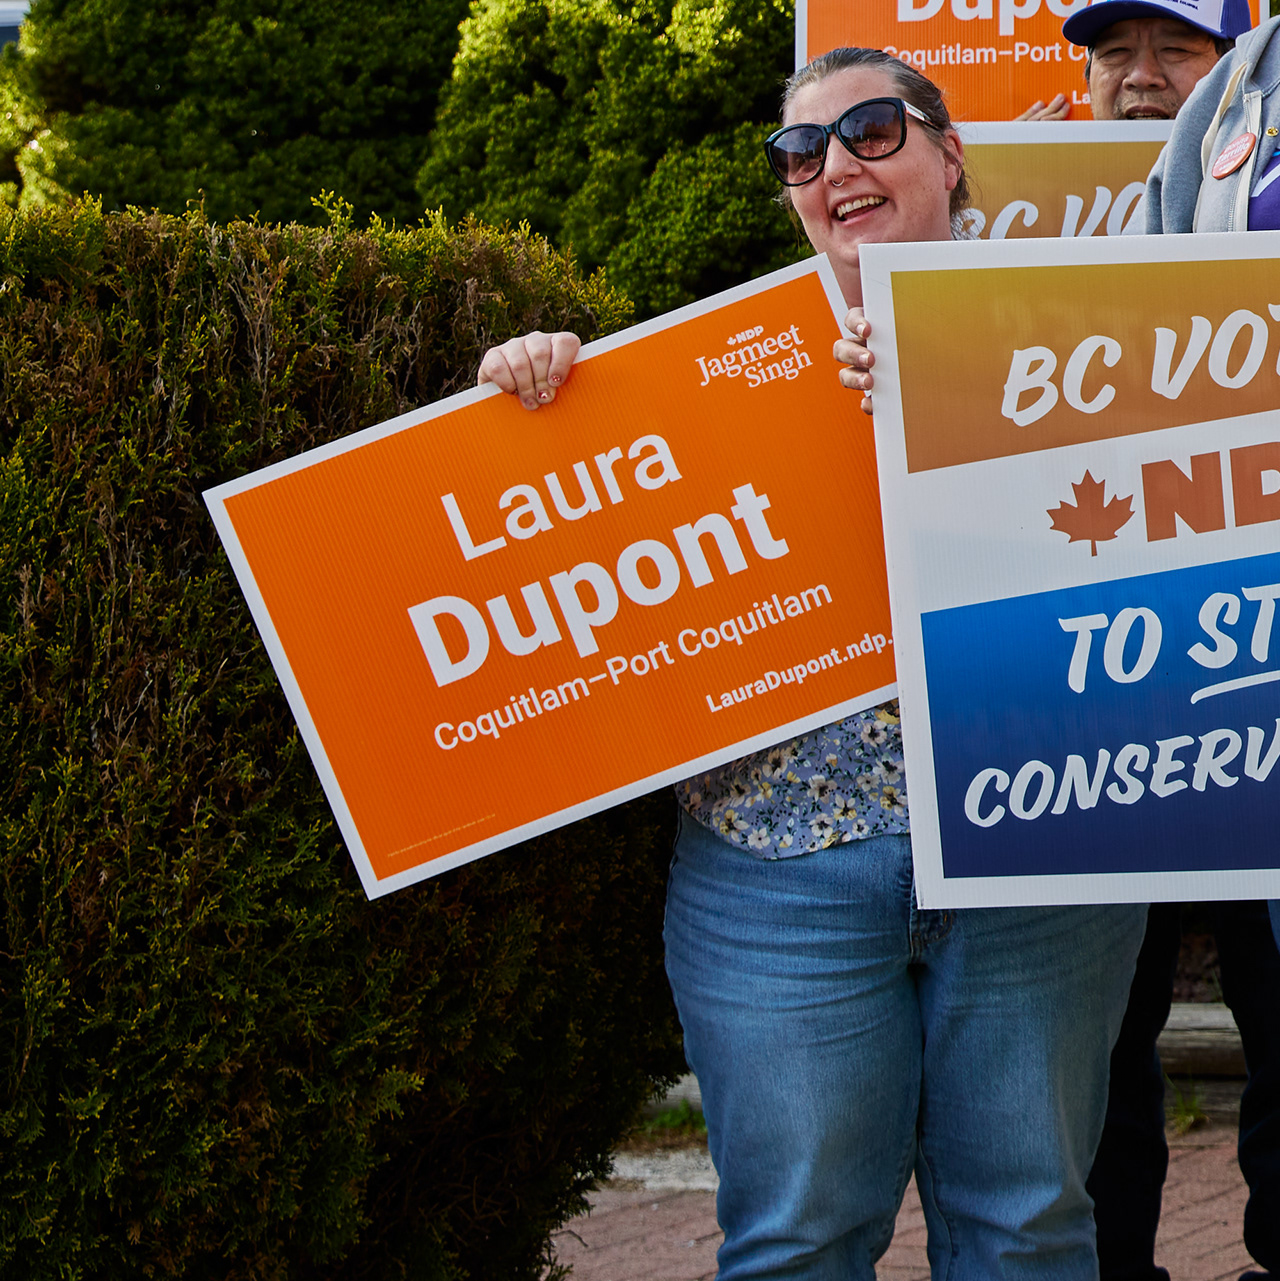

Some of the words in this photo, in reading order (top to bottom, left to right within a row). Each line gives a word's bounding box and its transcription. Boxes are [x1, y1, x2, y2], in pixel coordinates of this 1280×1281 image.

[695, 323, 804, 386] Jagmeet
[735, 326, 764, 344] NDP
[743, 348, 813, 388] Singh
[1000, 335, 1122, 427] BC
[440, 434, 683, 561] Laura
[407, 482, 790, 687] Dupont
[678, 581, 832, 656] Coquitlam
[705, 629, 896, 713] LauraDupont.ndp.
[1058, 607, 1163, 694] TO
